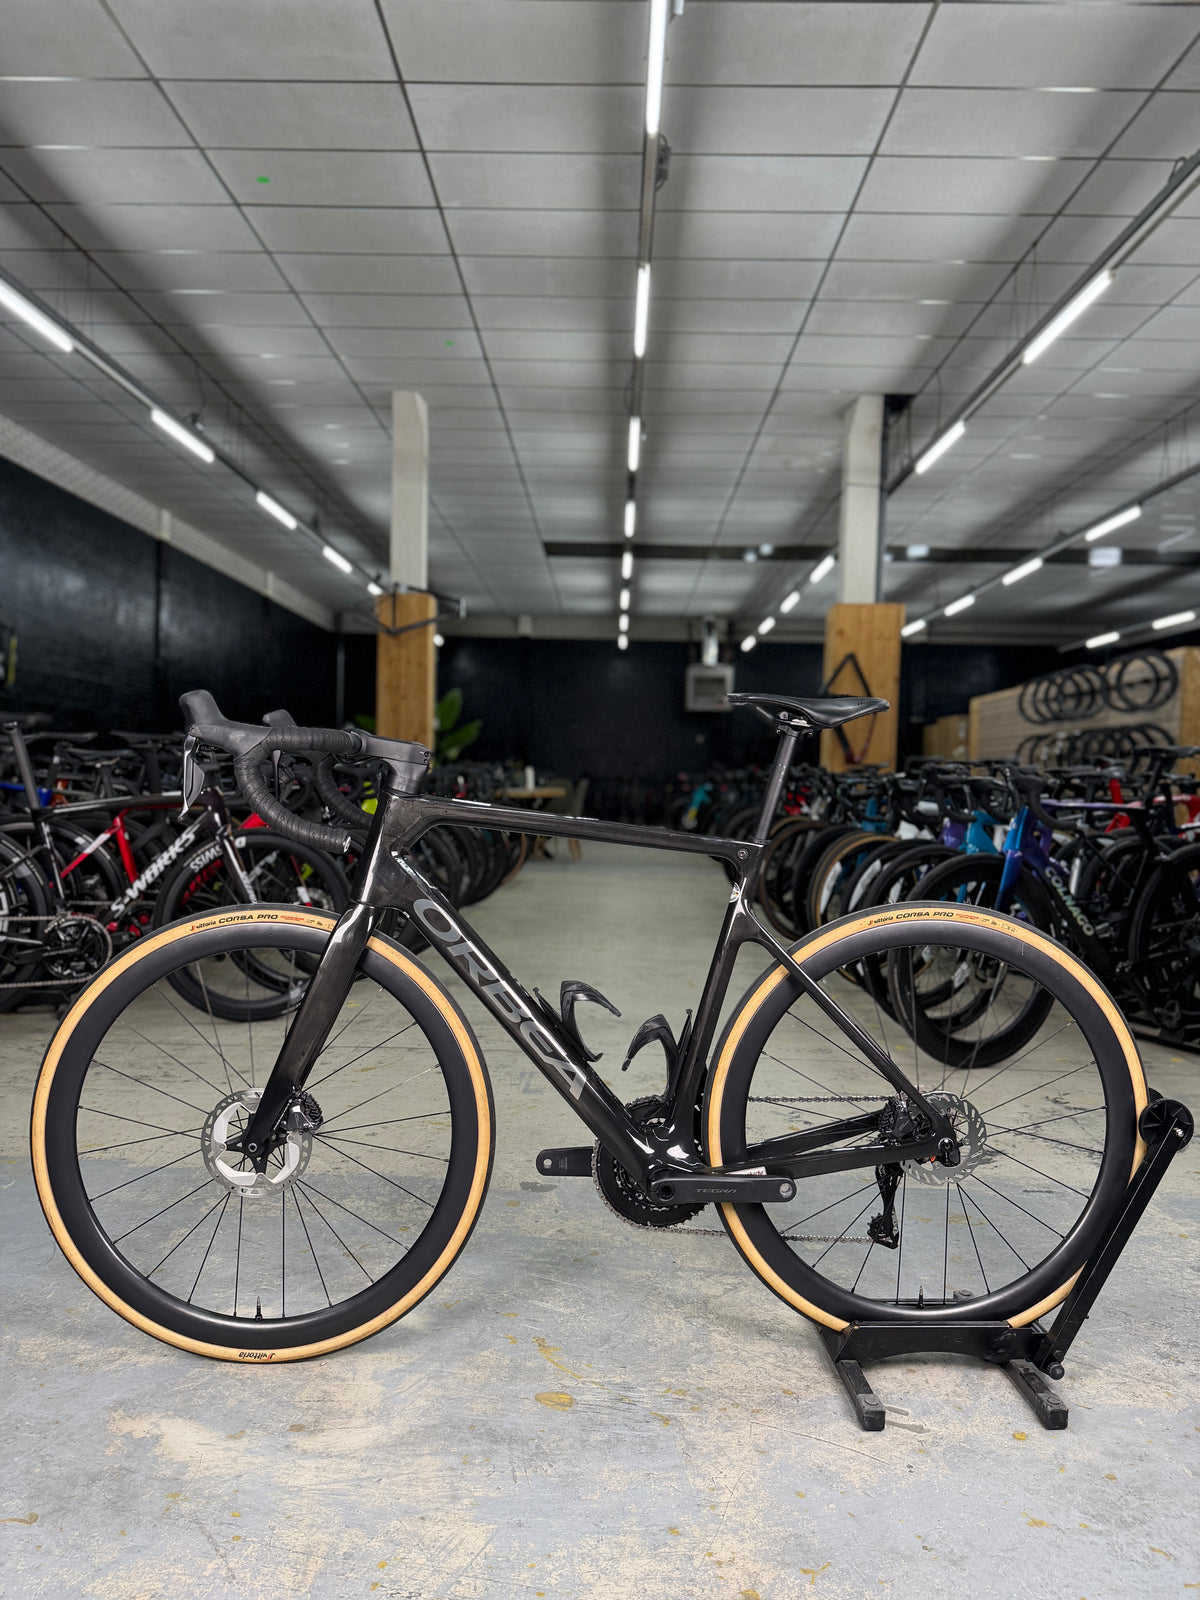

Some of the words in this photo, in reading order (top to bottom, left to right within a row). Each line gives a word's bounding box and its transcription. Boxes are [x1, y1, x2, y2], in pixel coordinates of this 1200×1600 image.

[110, 831, 195, 917] S-WORKS
[196, 919, 216, 929] vittoria
[218, 914, 254, 924] CORSA
[874, 915, 894, 924] vittoria
[896, 911, 930, 920] CORSA
[1045, 866, 1095, 936] COLNAGO
[413, 898, 587, 1100] ORBEA
[238, 1352, 268, 1360] vittoria
